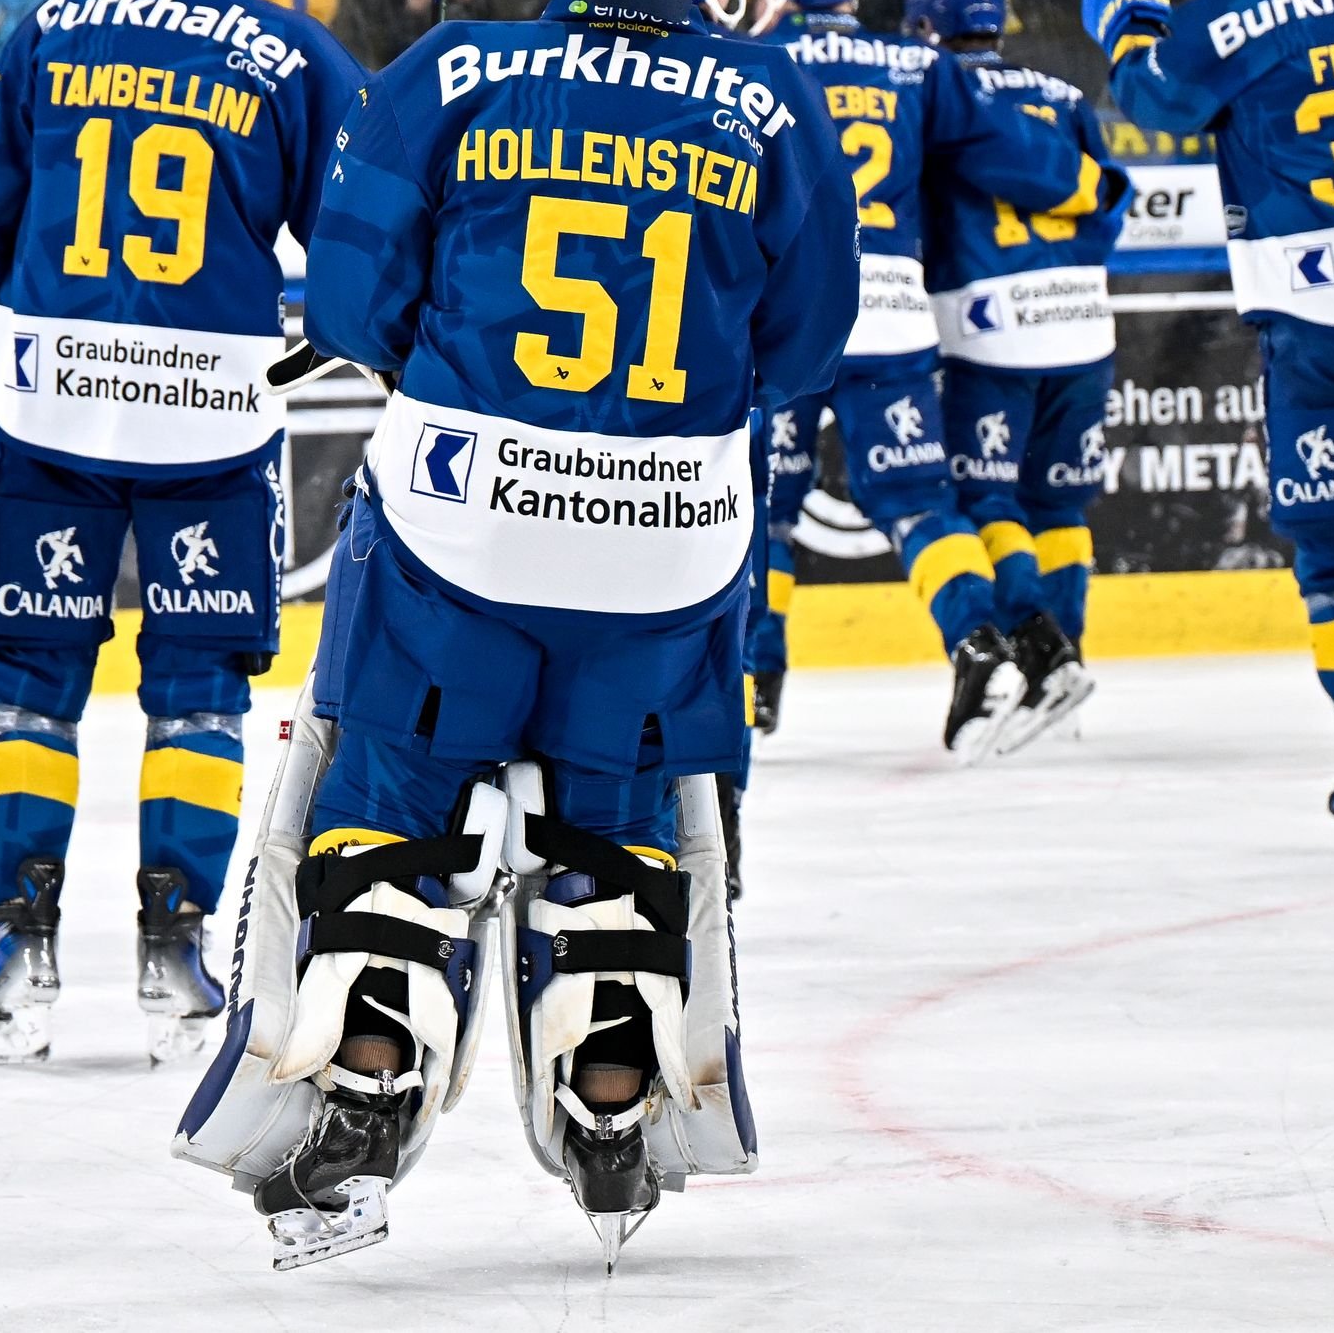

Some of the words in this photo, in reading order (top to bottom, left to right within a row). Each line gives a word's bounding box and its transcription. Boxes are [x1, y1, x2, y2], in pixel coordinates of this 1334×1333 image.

[588, 21, 615, 30] new
[618, 21, 670, 38] balance
[47, 62, 262, 137] TAMBELLINI
[437, 33, 797, 139] Burkhalter
[824, 84, 898, 123] EBEY
[712, 107, 766, 159] Group
[457, 128, 758, 216] HOLLENSTEIN
[841, 121, 896, 229] 2
[63, 117, 215, 287] 19
[512, 194, 694, 405] 51
[55, 334, 221, 372] Graubündner
[55, 368, 262, 414] Kantonalbank
[1104, 378, 1204, 427] ehen
[1214, 375, 1267, 423] au
[498, 437, 703, 483] Graubündner
[868, 441, 946, 473] CALANDA
[1140, 442, 1269, 493] META
[489, 475, 740, 531] Kantonalbank
[146, 581, 255, 615] CALANDA
